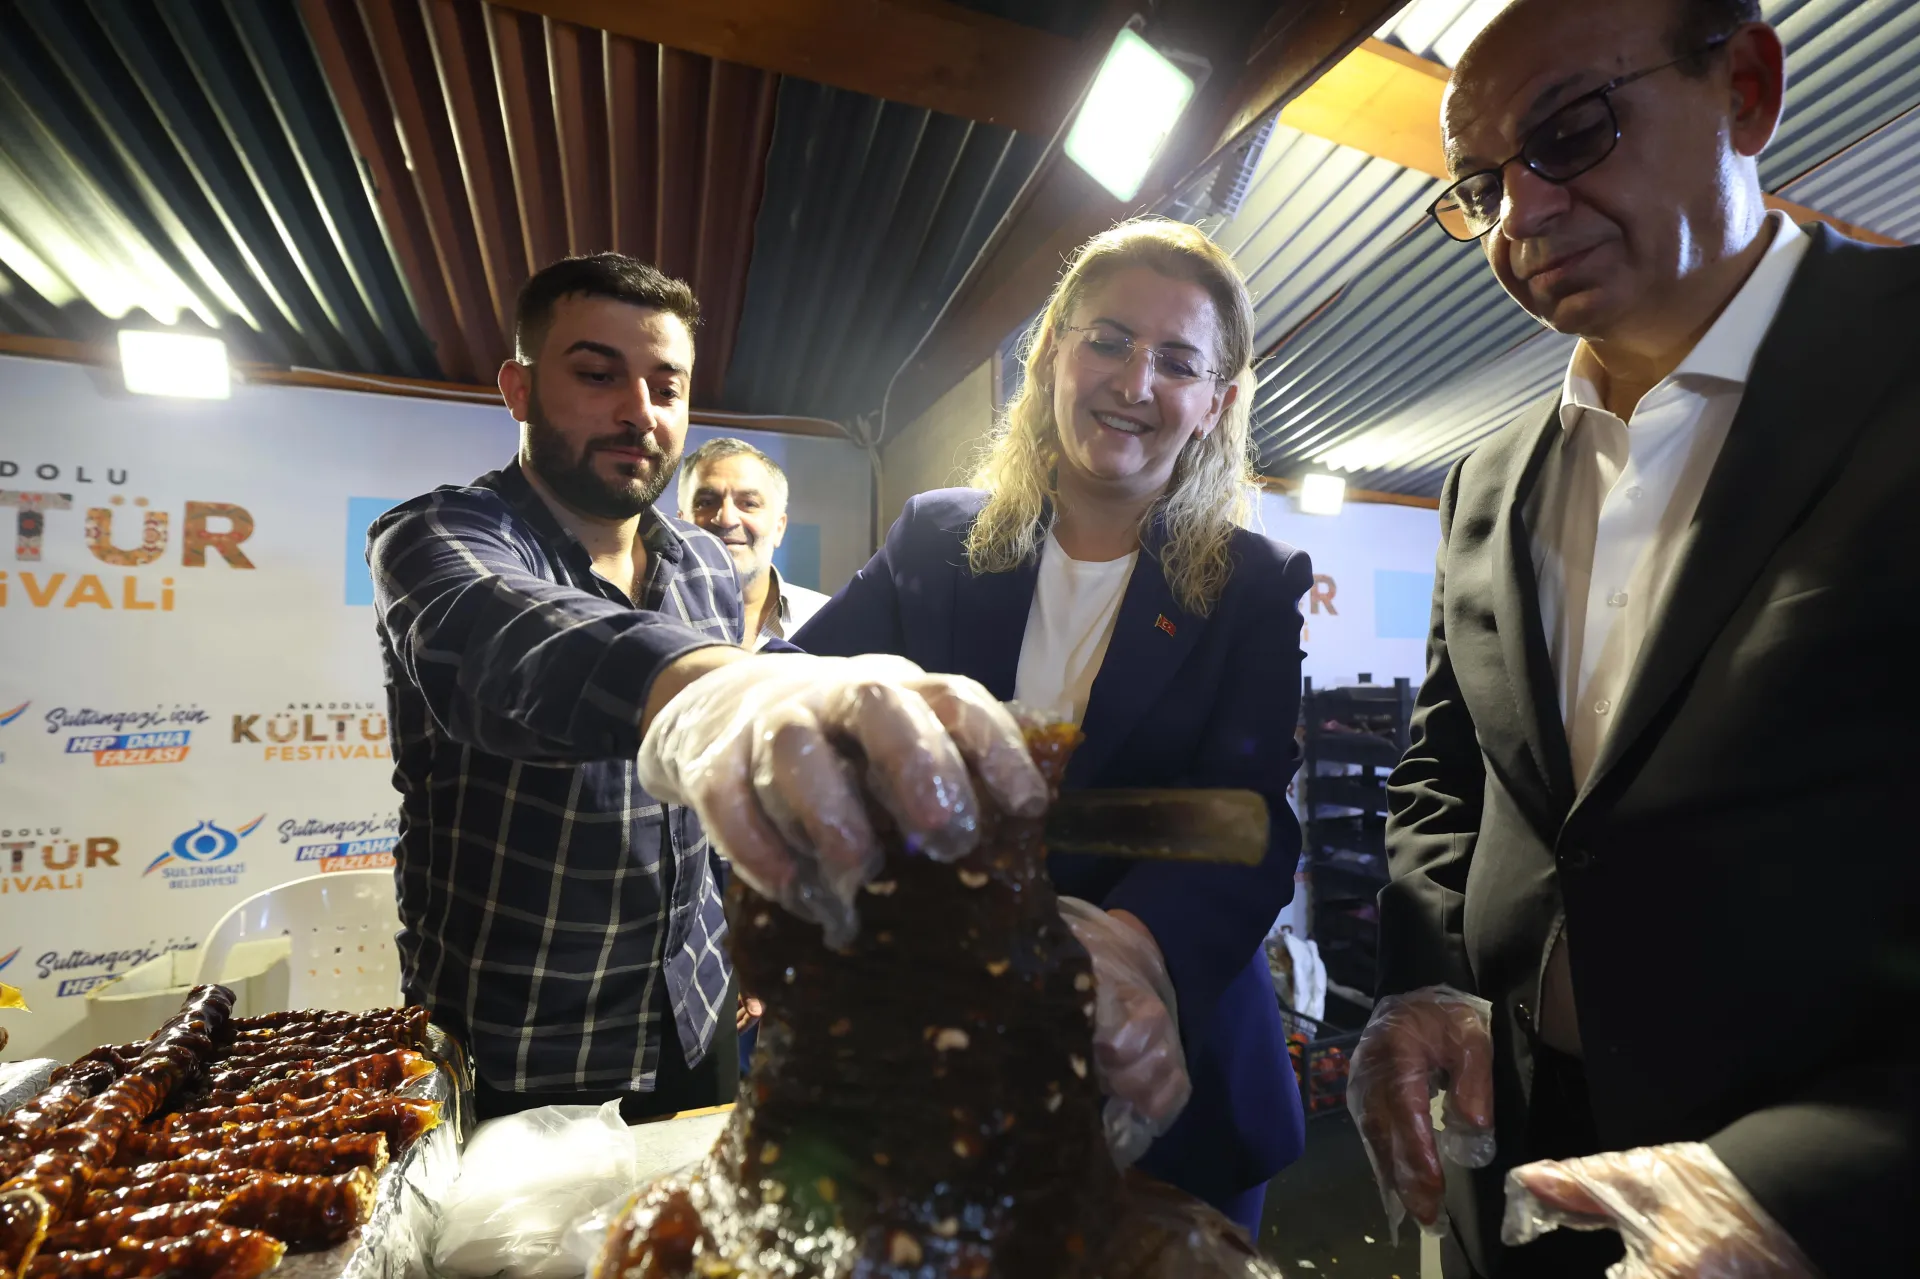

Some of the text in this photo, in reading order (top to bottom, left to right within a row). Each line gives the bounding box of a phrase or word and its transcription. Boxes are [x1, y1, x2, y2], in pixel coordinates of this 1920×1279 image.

[0, 460, 127, 485] DOLU
[0, 490, 256, 570] TÜR
[45, 703, 210, 734] Sultangazi için
[287, 702, 375, 710] ANADOLU
[70, 731, 185, 751] HEP DAHA
[100, 747, 182, 764] FAZLASI
[1, 827, 61, 838] DOLU
[278, 812, 380, 843] Sultangazi
[0, 837, 121, 872] TÜR
[300, 844, 339, 859] HEP
[36, 939, 160, 979] Sultangazi
